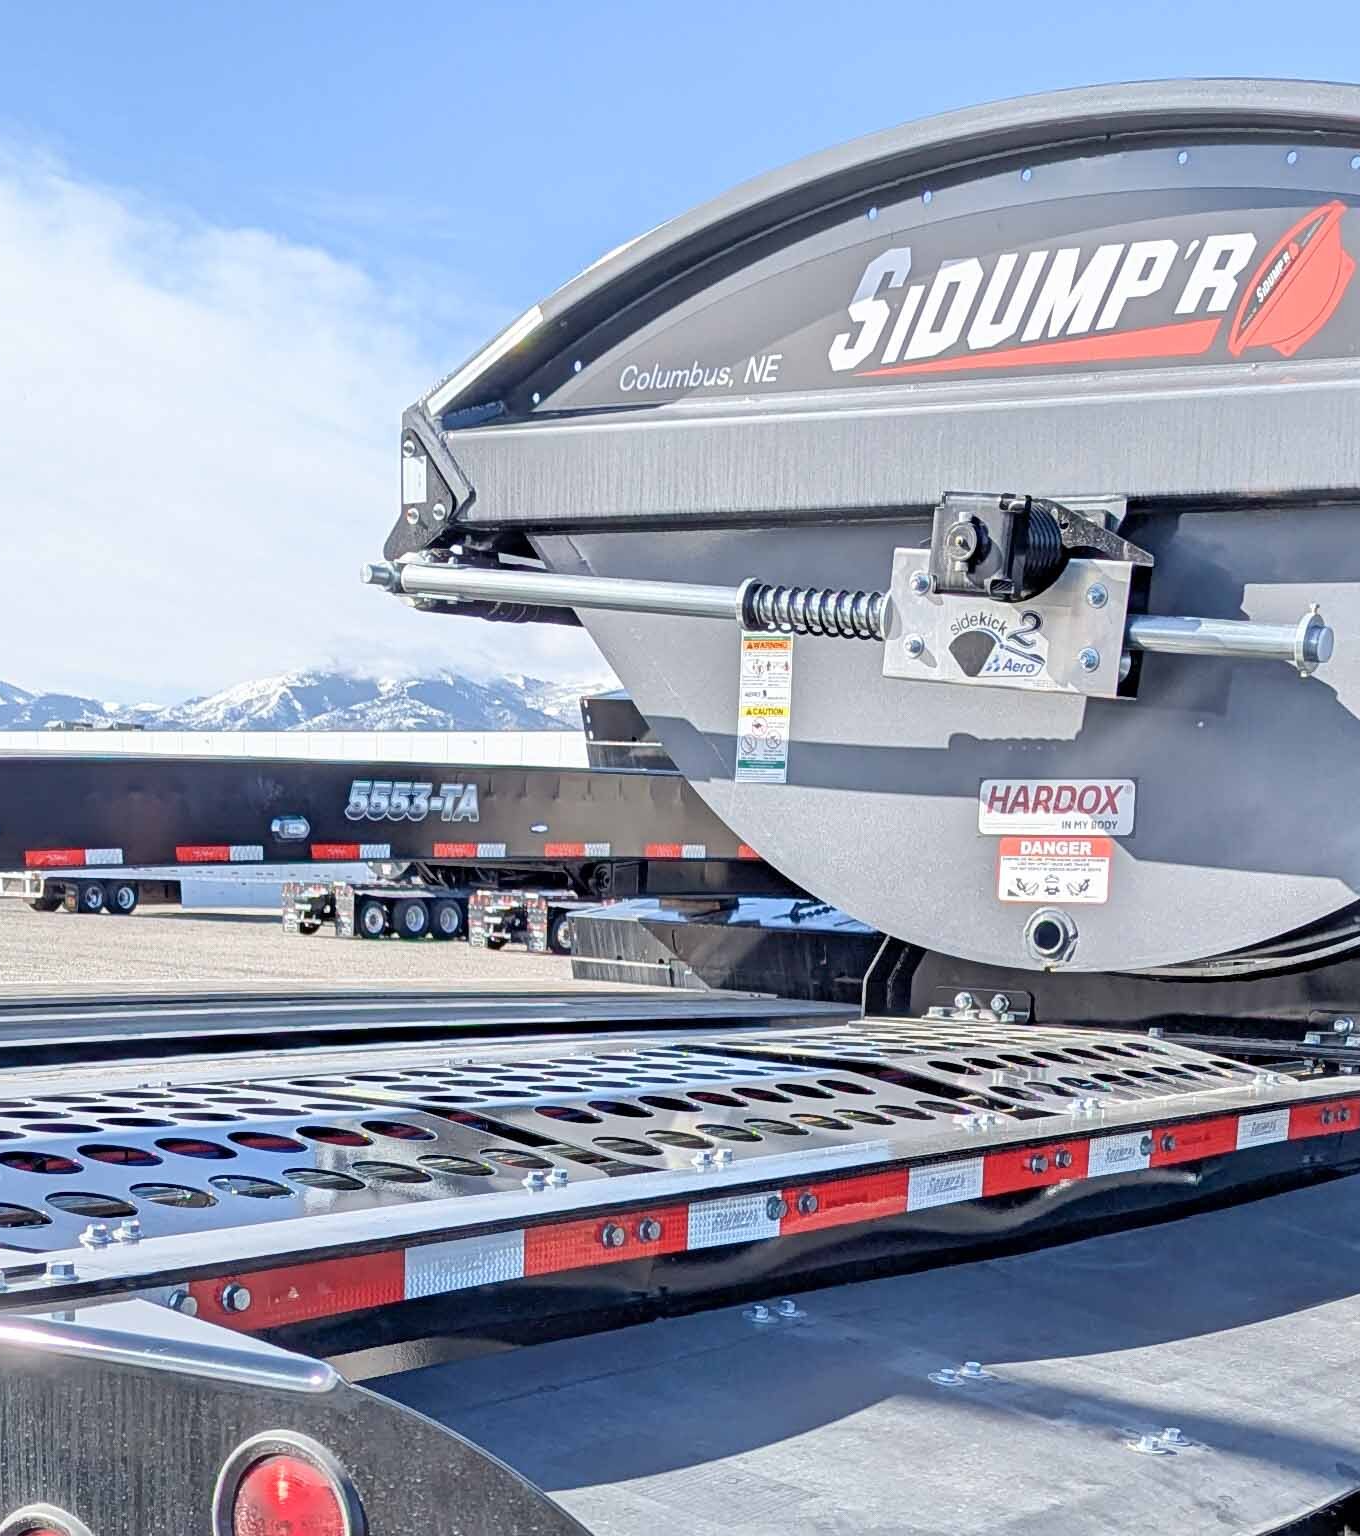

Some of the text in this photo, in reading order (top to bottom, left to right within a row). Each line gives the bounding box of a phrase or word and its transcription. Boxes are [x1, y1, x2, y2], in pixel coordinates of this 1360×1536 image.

[618, 353, 783, 393] Columbus, NE
[949, 611, 1009, 637] sidekick
[1001, 657, 1035, 674] Aero
[752, 708, 784, 716] CAUTION
[344, 779, 480, 823] 5553-TA
[986, 784, 1124, 815] HARDOX
[1061, 820, 1071, 830] IN
[1073, 820, 1089, 830] MY
[1020, 840, 1092, 856] DANGER
